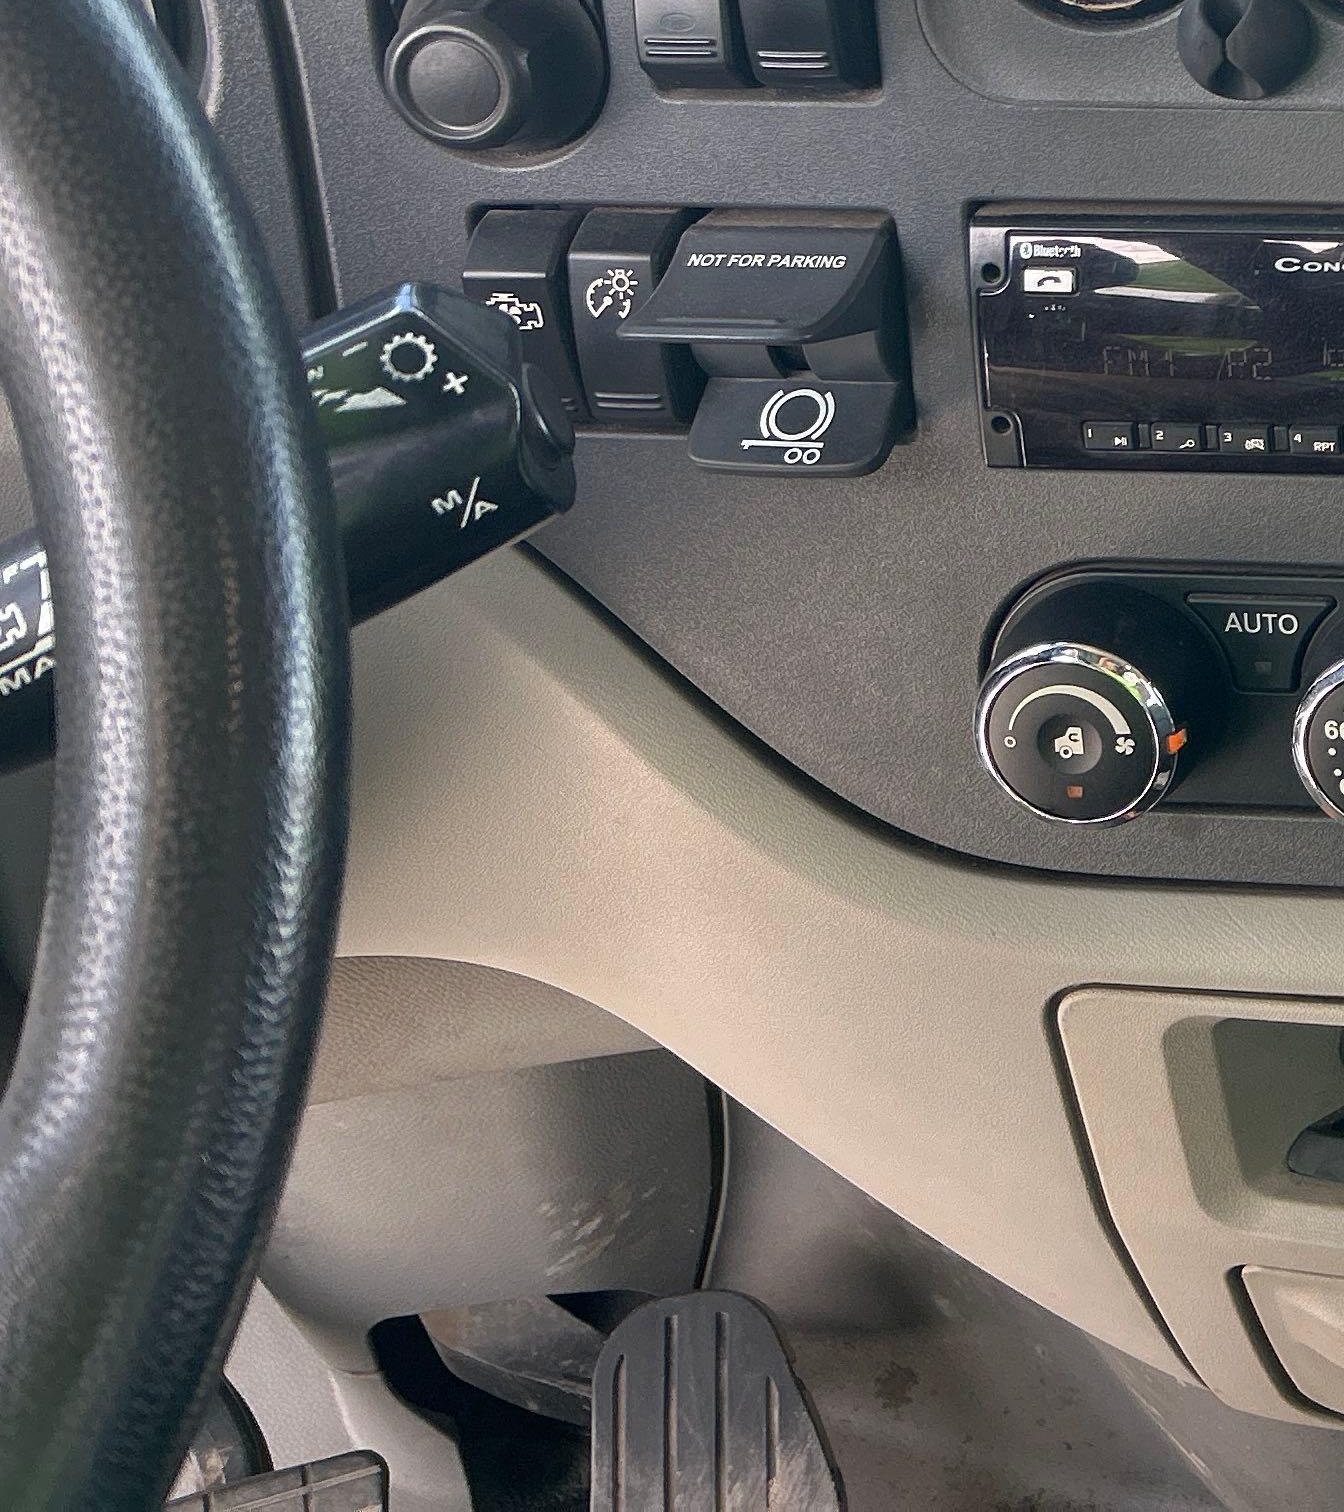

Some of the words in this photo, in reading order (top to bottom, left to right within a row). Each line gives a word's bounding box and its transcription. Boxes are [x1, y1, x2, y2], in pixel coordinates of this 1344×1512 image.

[687, 253, 727, 267] NOT
[727, 254, 765, 268] FOR
[766, 254, 847, 269] PARKING
[1156, 430, 1165, 440] 2
[1224, 432, 1233, 443] 3
[1294, 433, 1303, 444] 4
[1313, 441, 1336, 452] RPT
[1224, 612, 1298, 635] AUTO
